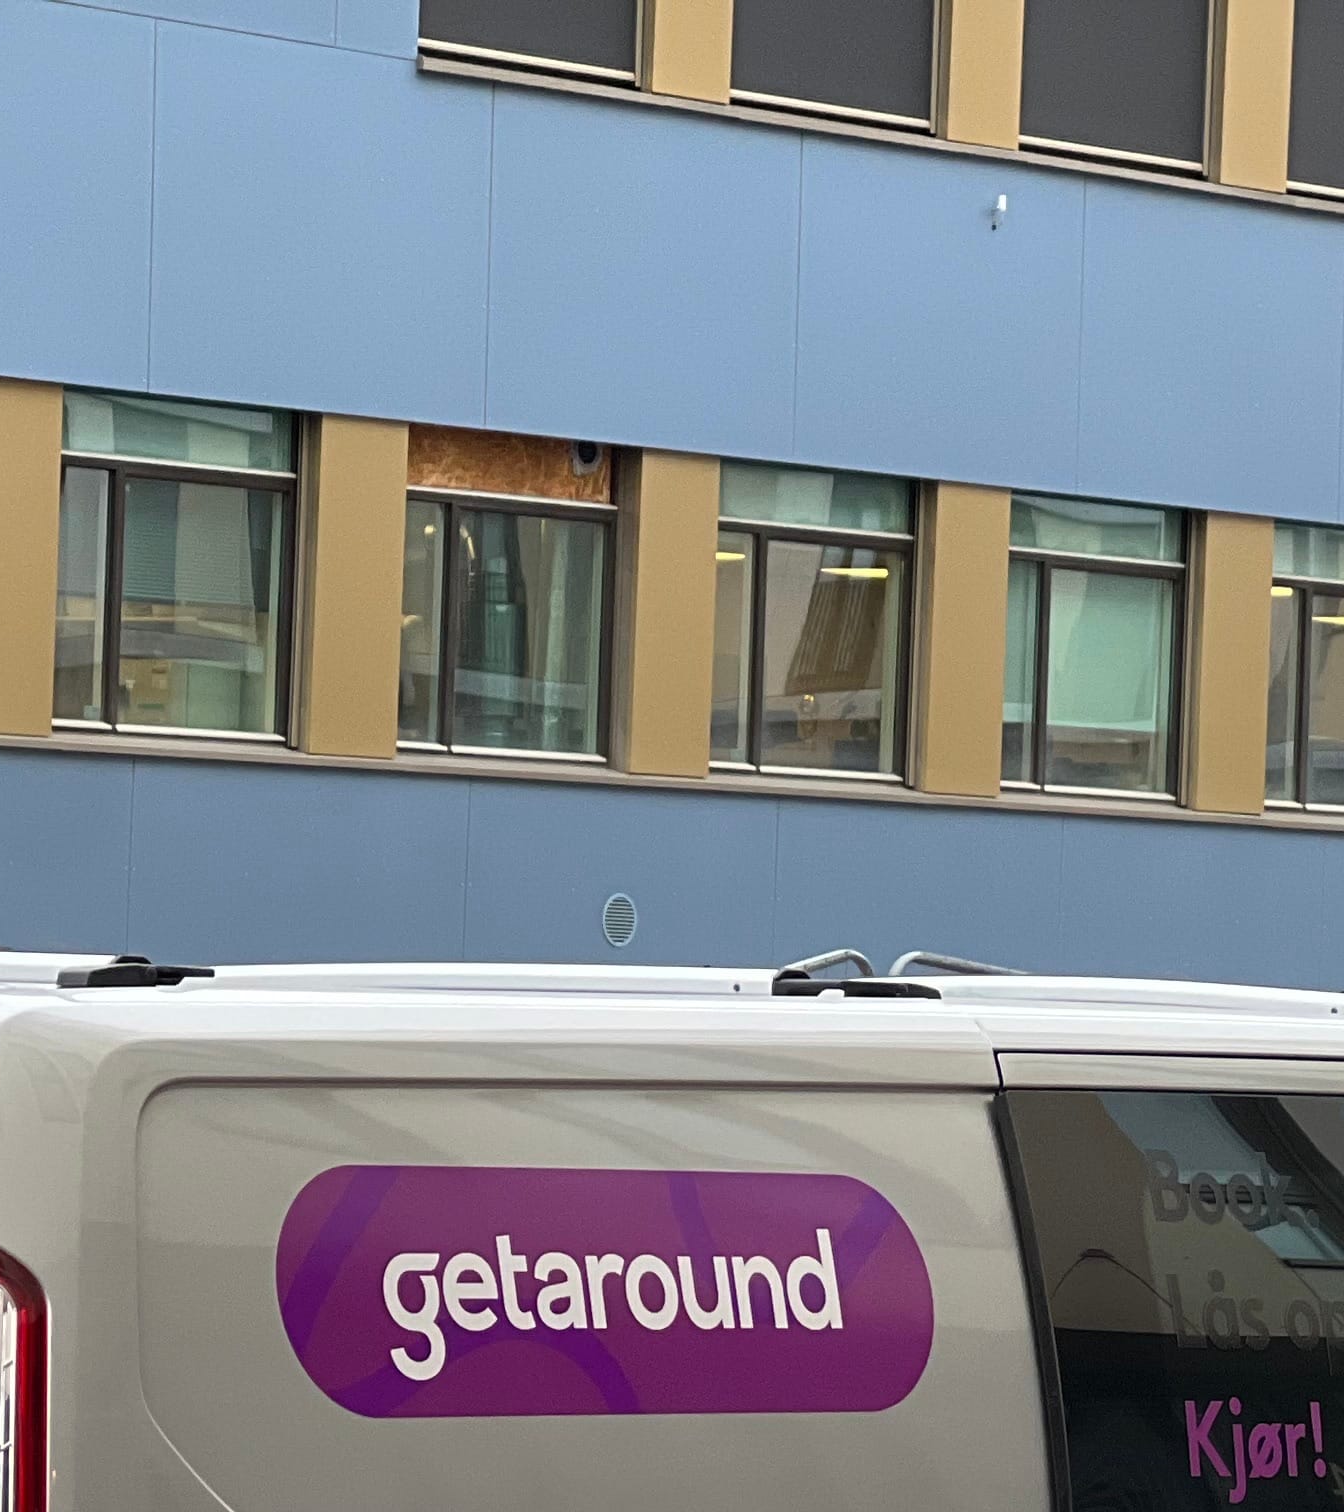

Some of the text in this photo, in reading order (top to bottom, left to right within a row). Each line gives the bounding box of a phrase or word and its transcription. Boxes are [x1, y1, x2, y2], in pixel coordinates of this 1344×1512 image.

[1143, 1149, 1320, 1232] Book.
[383, 1228, 843, 1380] getaround
[1166, 1269, 1271, 1351] Lås
[1184, 1397, 1328, 1504] Kjør!
